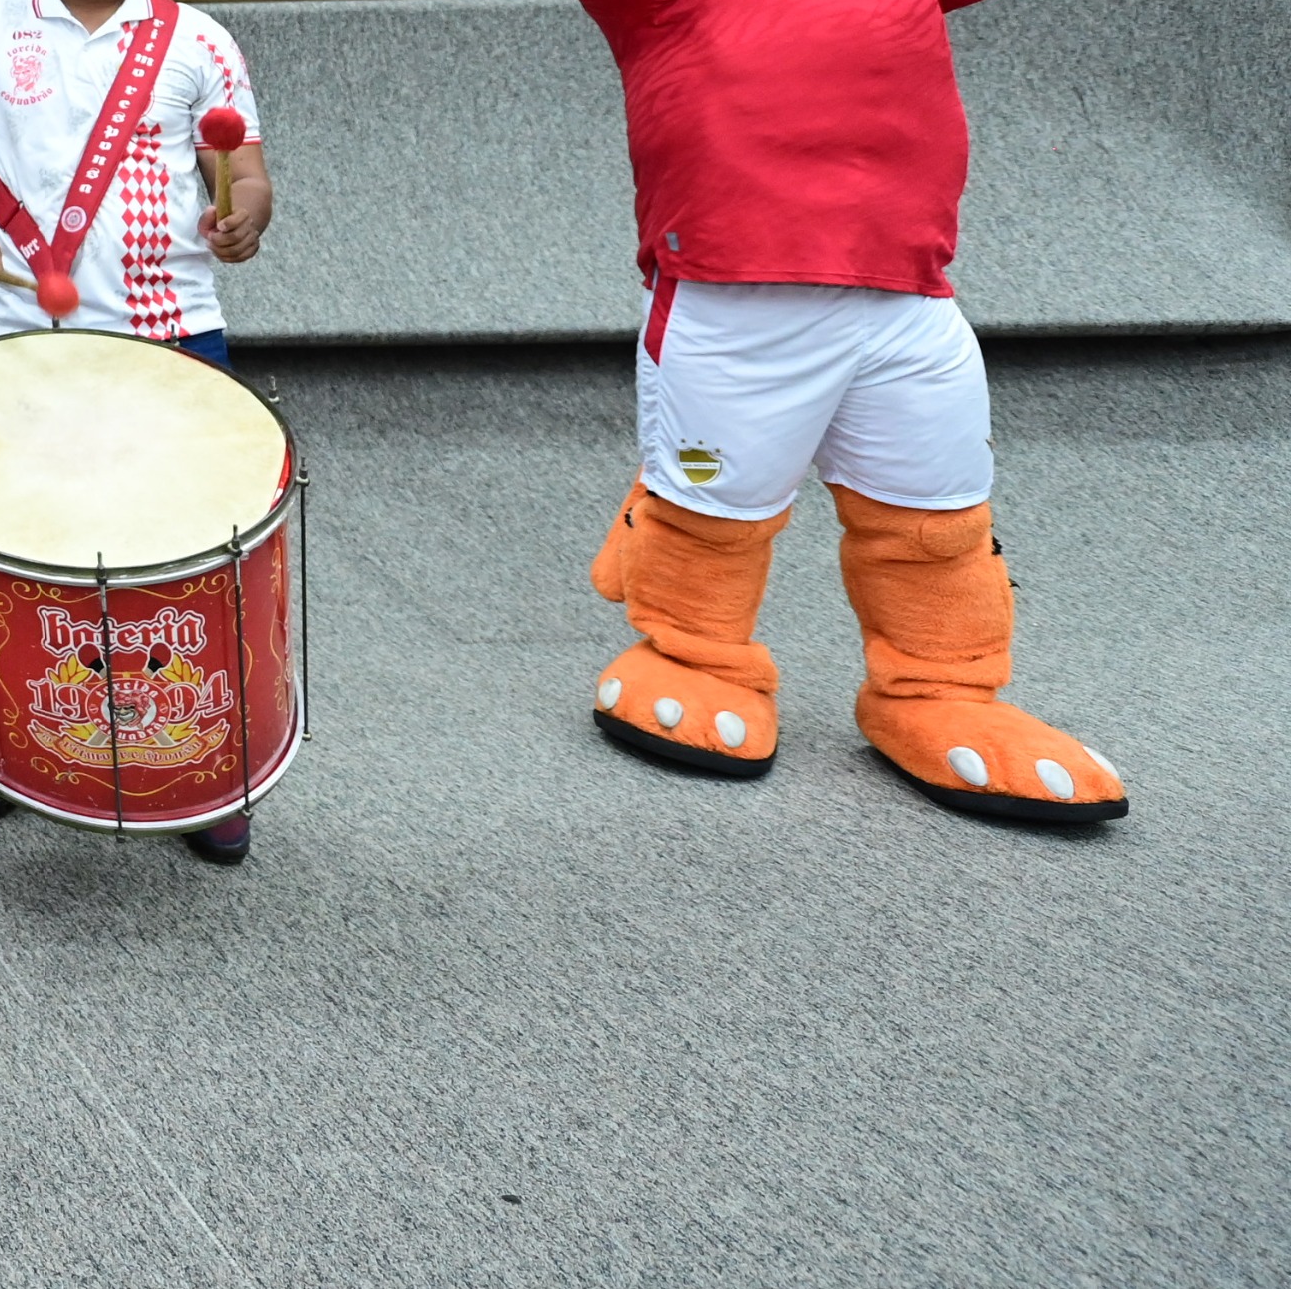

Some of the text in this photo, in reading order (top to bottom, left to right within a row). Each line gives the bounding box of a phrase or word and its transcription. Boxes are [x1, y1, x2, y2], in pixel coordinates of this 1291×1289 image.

[12, 29, 43, 41] 082
[7, 43, 47, 57] torcida
[0, 87, 53, 107] esquadrão
[39, 608, 206, 655] bateria
